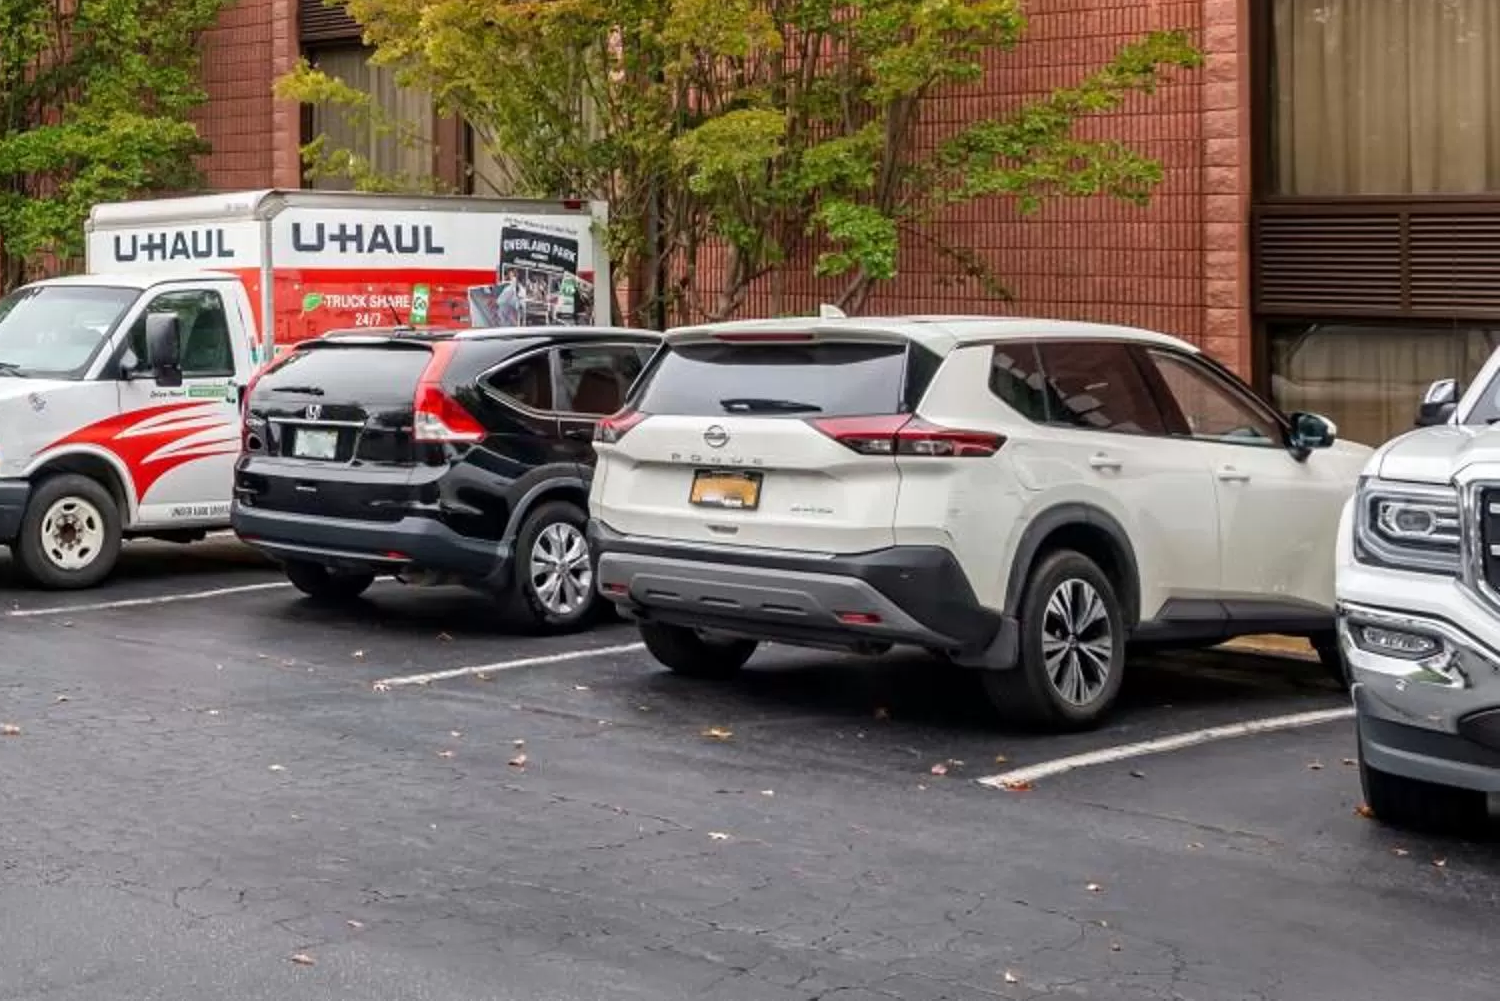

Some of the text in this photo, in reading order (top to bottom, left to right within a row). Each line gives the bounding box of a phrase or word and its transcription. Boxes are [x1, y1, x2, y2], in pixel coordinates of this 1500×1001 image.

[114, 228, 235, 262] U-HAUL
[292, 222, 445, 254] U-HAUL
[503, 239, 551, 254] OVERLAND
[552, 244, 577, 262] PARK
[324, 294, 411, 308] TRUCK SHARE
[355, 312, 381, 326] 24/7
